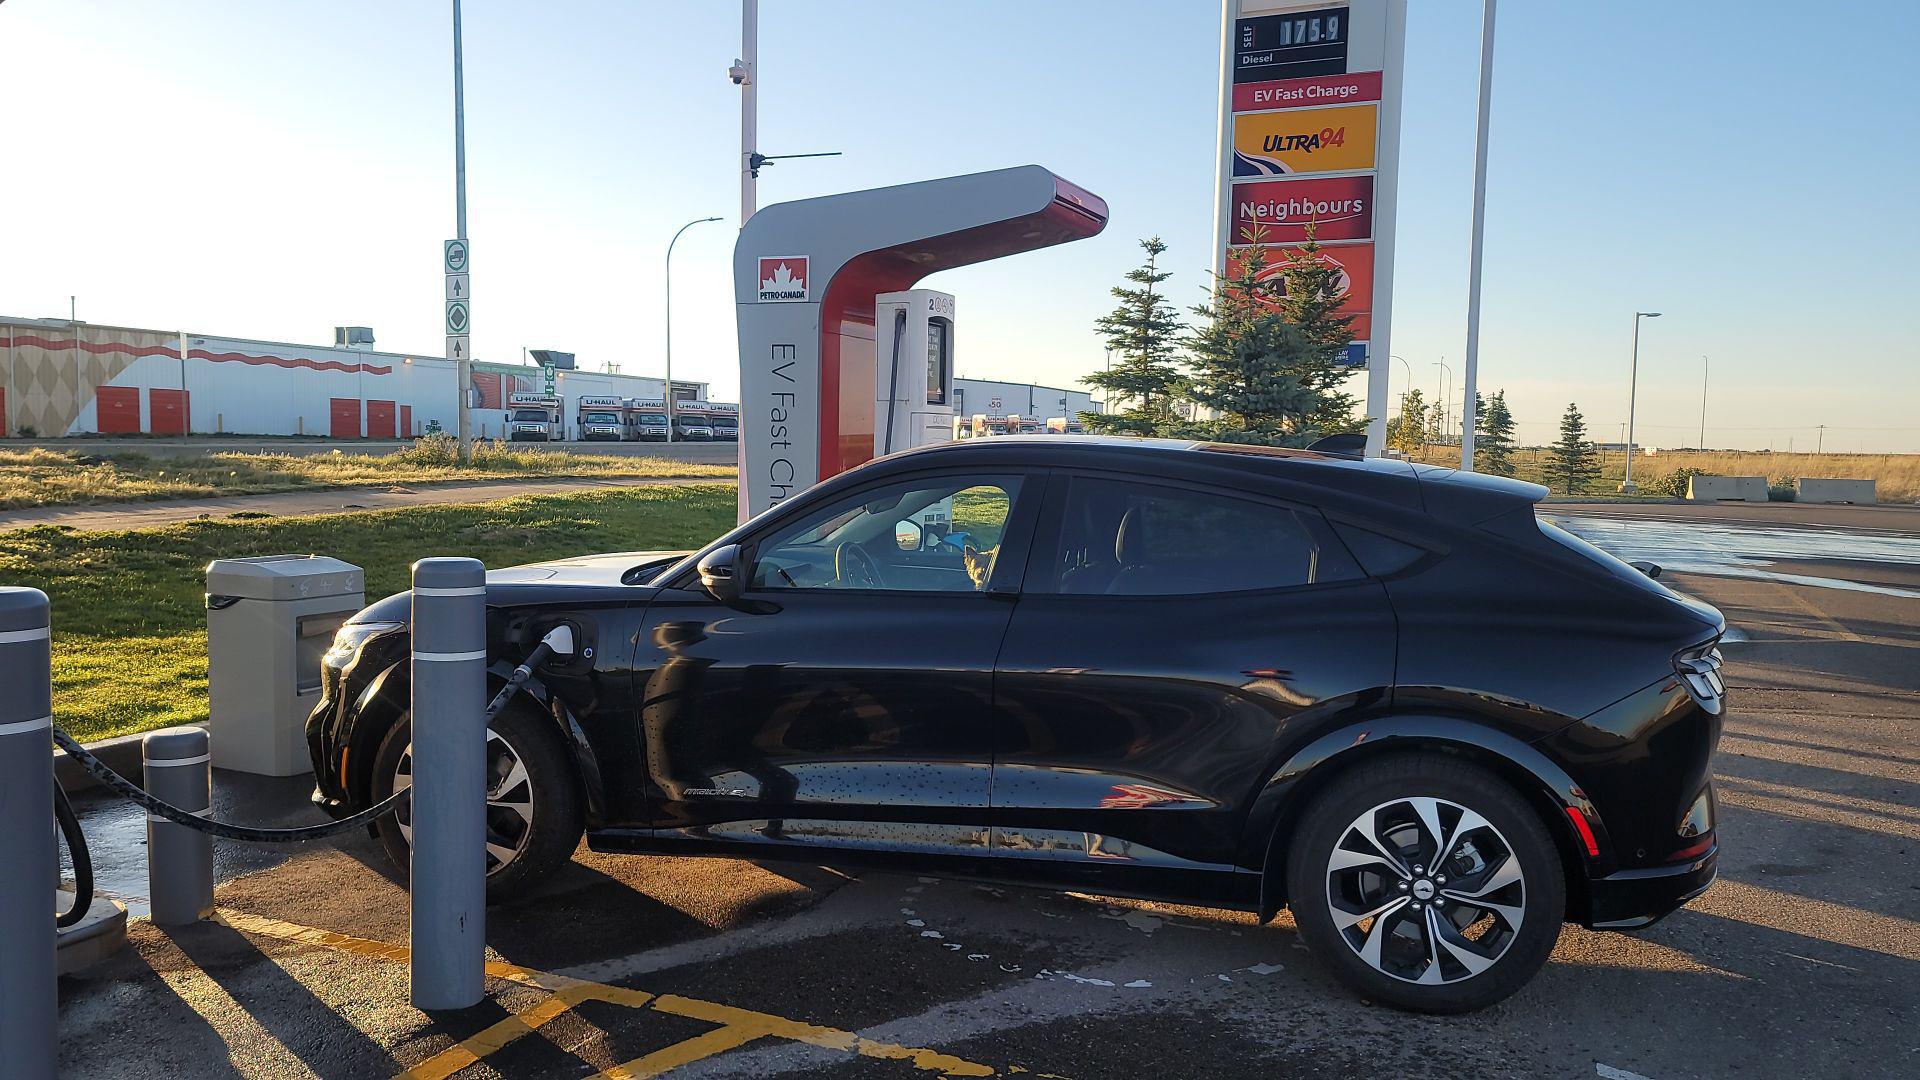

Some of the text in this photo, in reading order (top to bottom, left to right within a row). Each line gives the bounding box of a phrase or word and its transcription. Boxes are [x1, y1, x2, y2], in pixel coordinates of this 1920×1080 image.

[1243, 25, 1252, 48] SELF
[1280, 15, 1339, 45] 175.9
[1242, 53, 1273, 65] Diesel
[1254, 84, 1359, 103] EV Fast Charge
[1240, 198, 1363, 221] Neighbours
[928, 298, 935, 311] 2
[770, 343, 796, 384] EV
[770, 391, 795, 451] Fast
